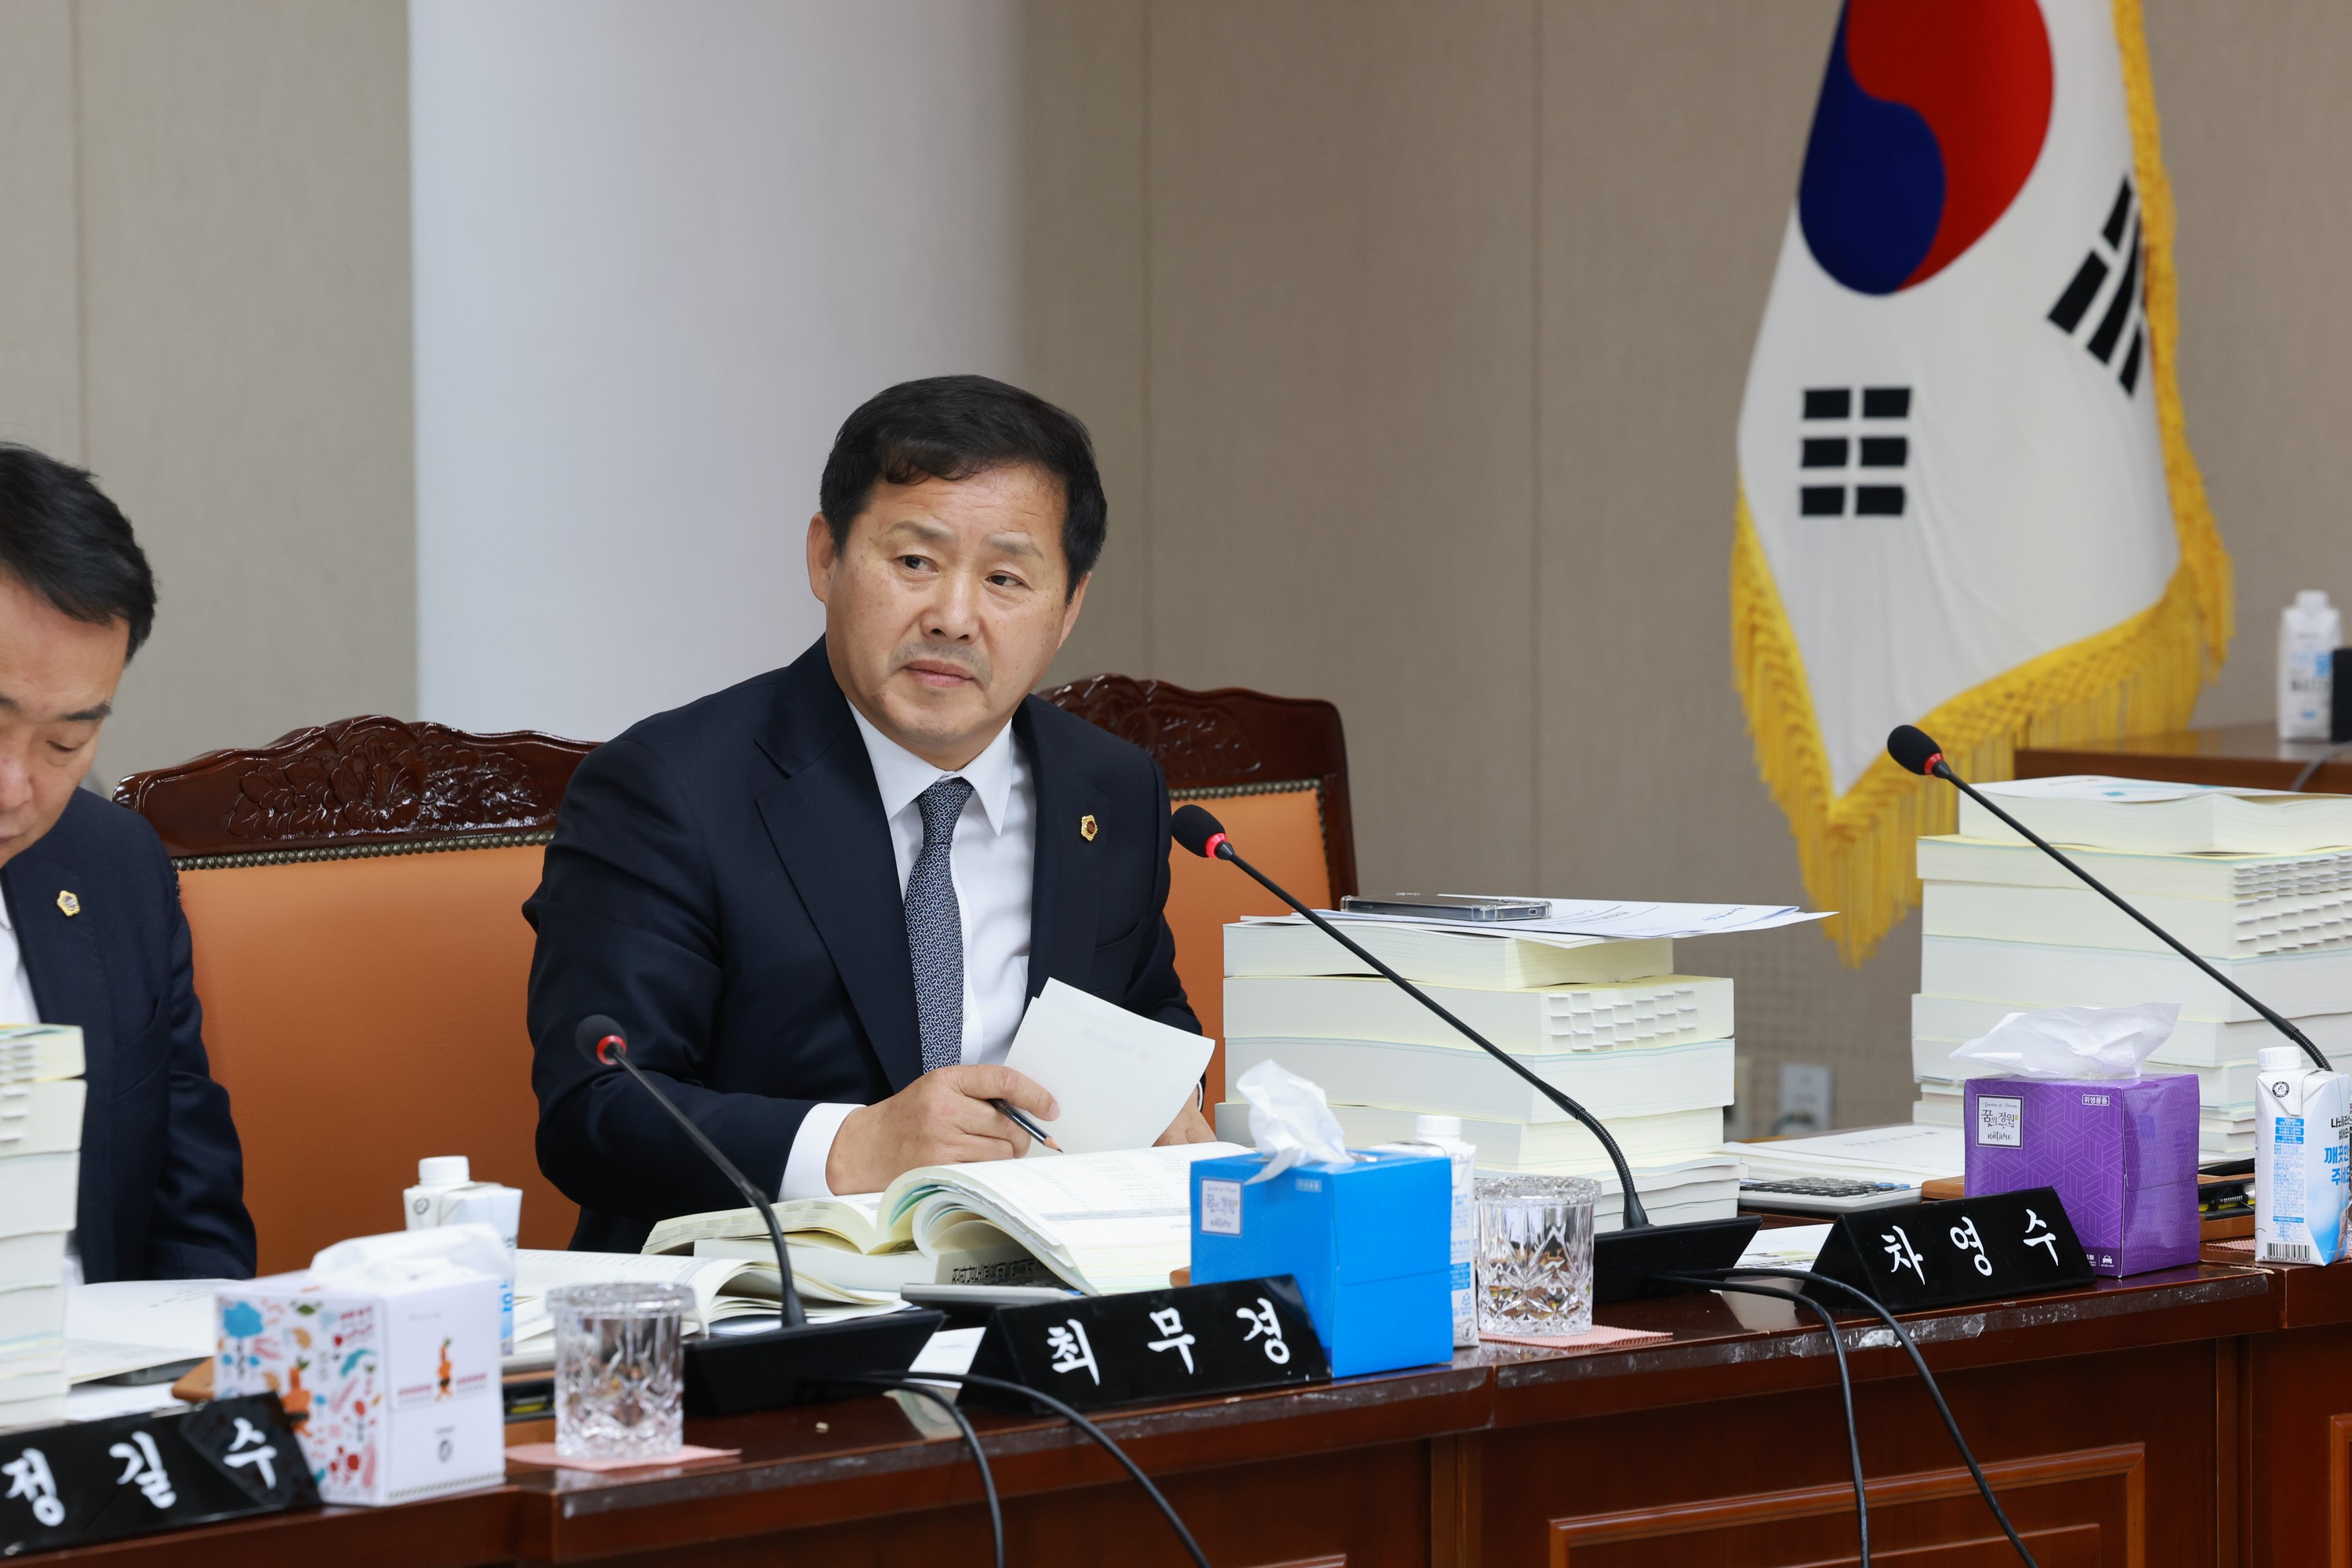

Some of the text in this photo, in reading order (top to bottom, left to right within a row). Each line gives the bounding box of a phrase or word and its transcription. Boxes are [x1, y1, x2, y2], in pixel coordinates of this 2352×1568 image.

[1981, 1109, 2015, 1125] 꿈의 정원
[2084, 1096, 2108, 1105] 위생용품
[2324, 1144, 2349, 1164] 깨끗한
[1882, 1209, 2058, 1285] 차영수
[1047, 1298, 1290, 1385] 최무경
[1, 1417, 277, 1526] 정길수
